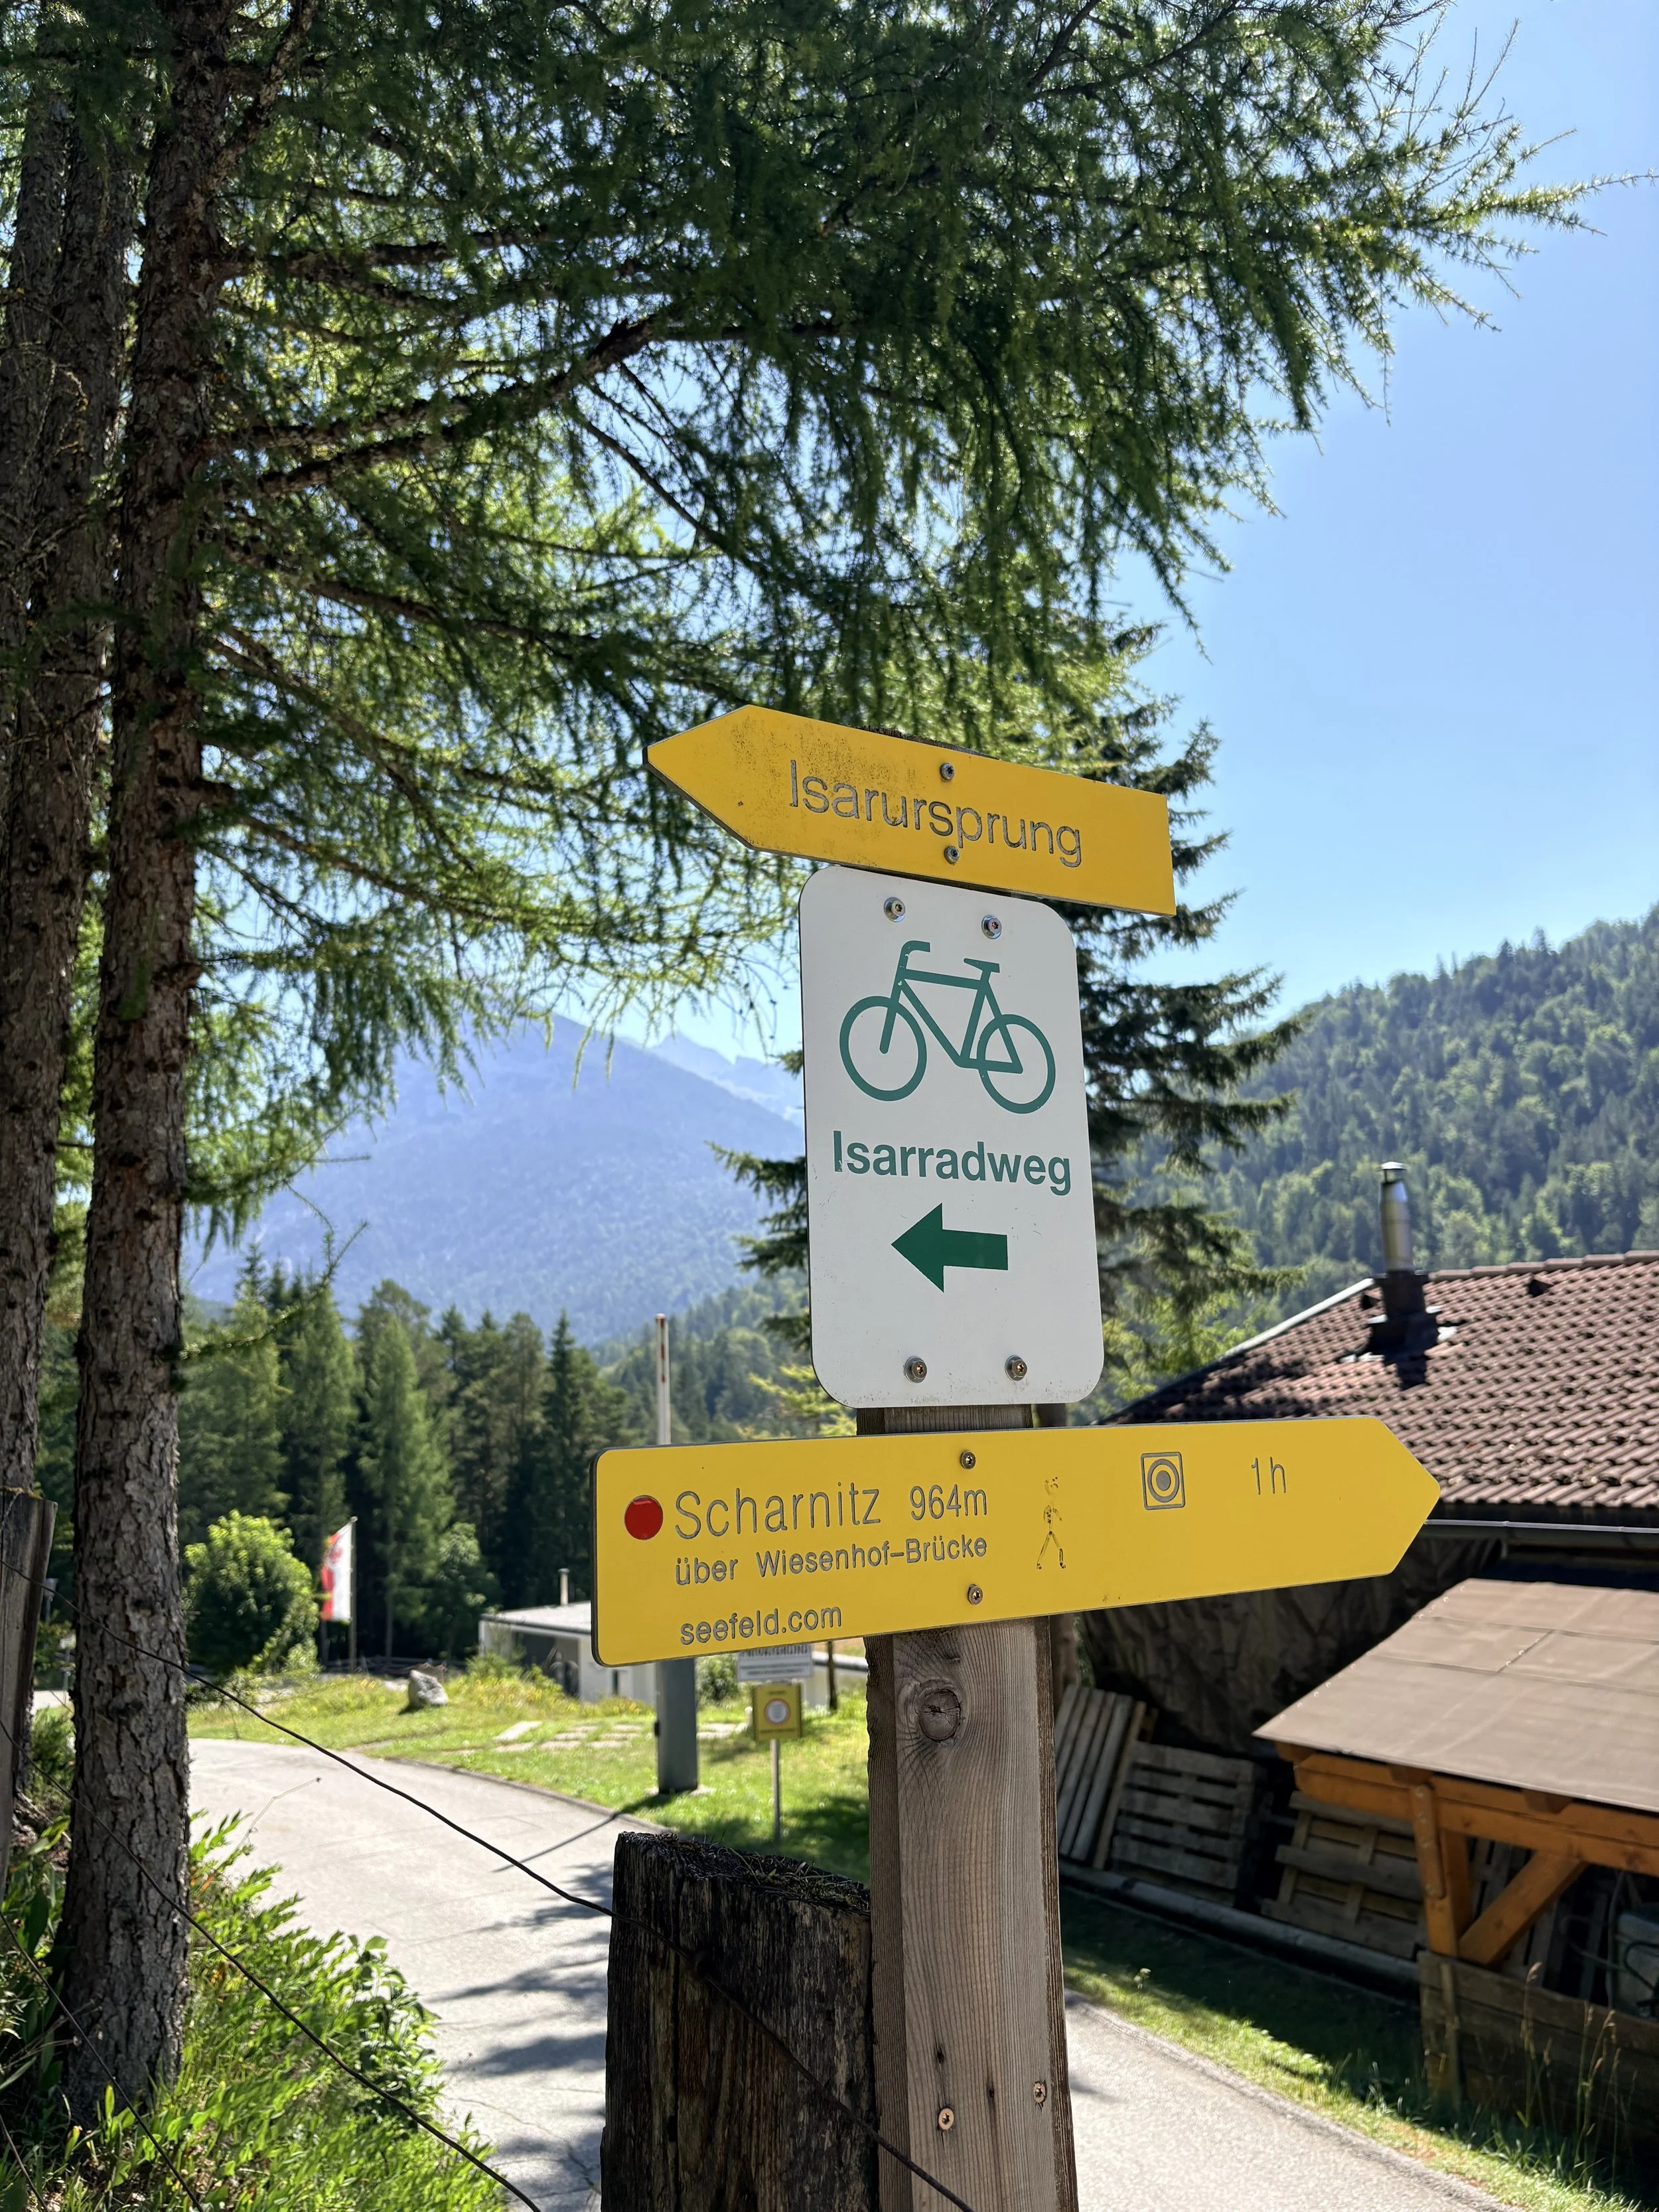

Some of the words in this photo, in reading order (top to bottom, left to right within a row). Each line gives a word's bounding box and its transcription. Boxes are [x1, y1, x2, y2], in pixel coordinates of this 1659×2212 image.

[789, 759, 1082, 868] Isarursprung
[833, 1130, 1071, 1196] Isarradweg
[674, 1481, 881, 1540] Scharnitz
[909, 1484, 987, 1521] 964m
[1251, 1456, 1287, 1495] 1h
[675, 1556, 739, 1586] über
[755, 1534, 987, 1578] Wiesenhof-Brücke
[680, 1605, 842, 1645] seefeld.com
